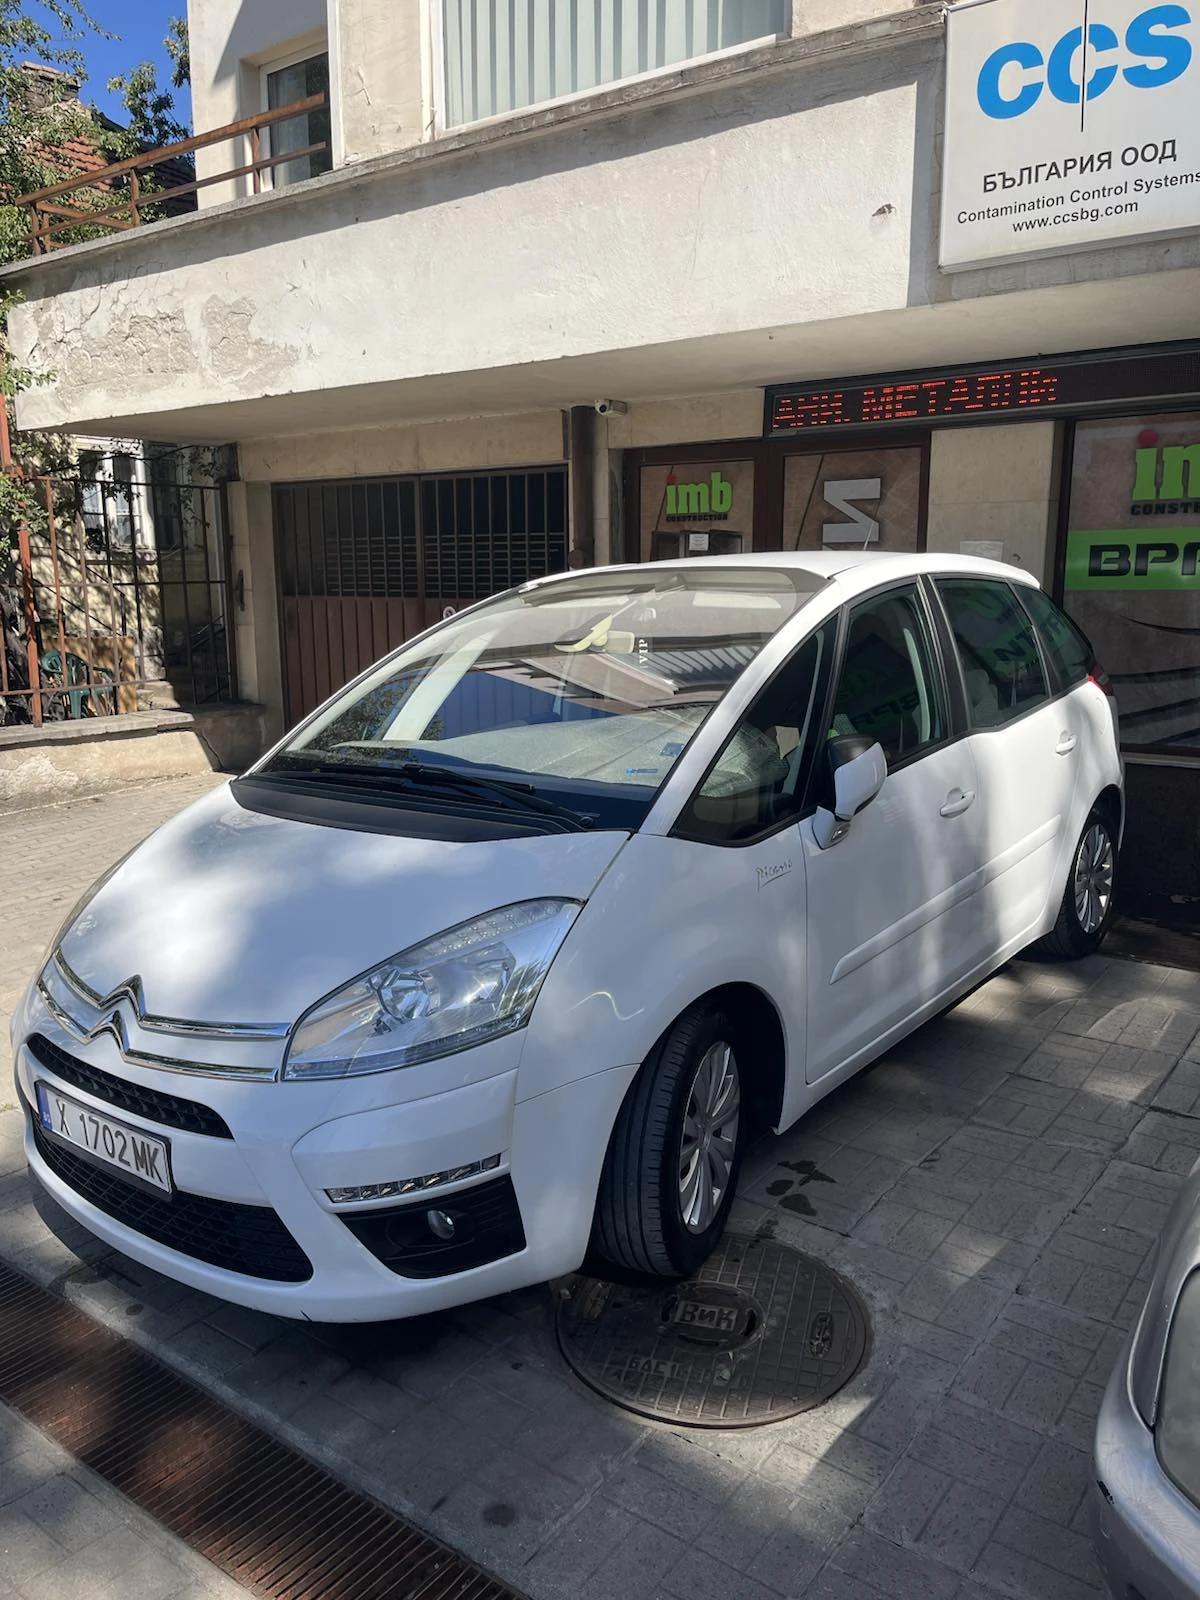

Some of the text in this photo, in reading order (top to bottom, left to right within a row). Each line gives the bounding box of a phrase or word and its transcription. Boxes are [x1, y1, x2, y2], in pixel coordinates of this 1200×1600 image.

[977, 4, 1192, 120] CCS
[983, 139, 1177, 193] БЪЛГАРИЯ ООД
[957, 171, 1200, 224] Contamination Control Systems
[1012, 201, 1139, 233] www.ccsbg.com
[666, 471, 732, 514] imb
